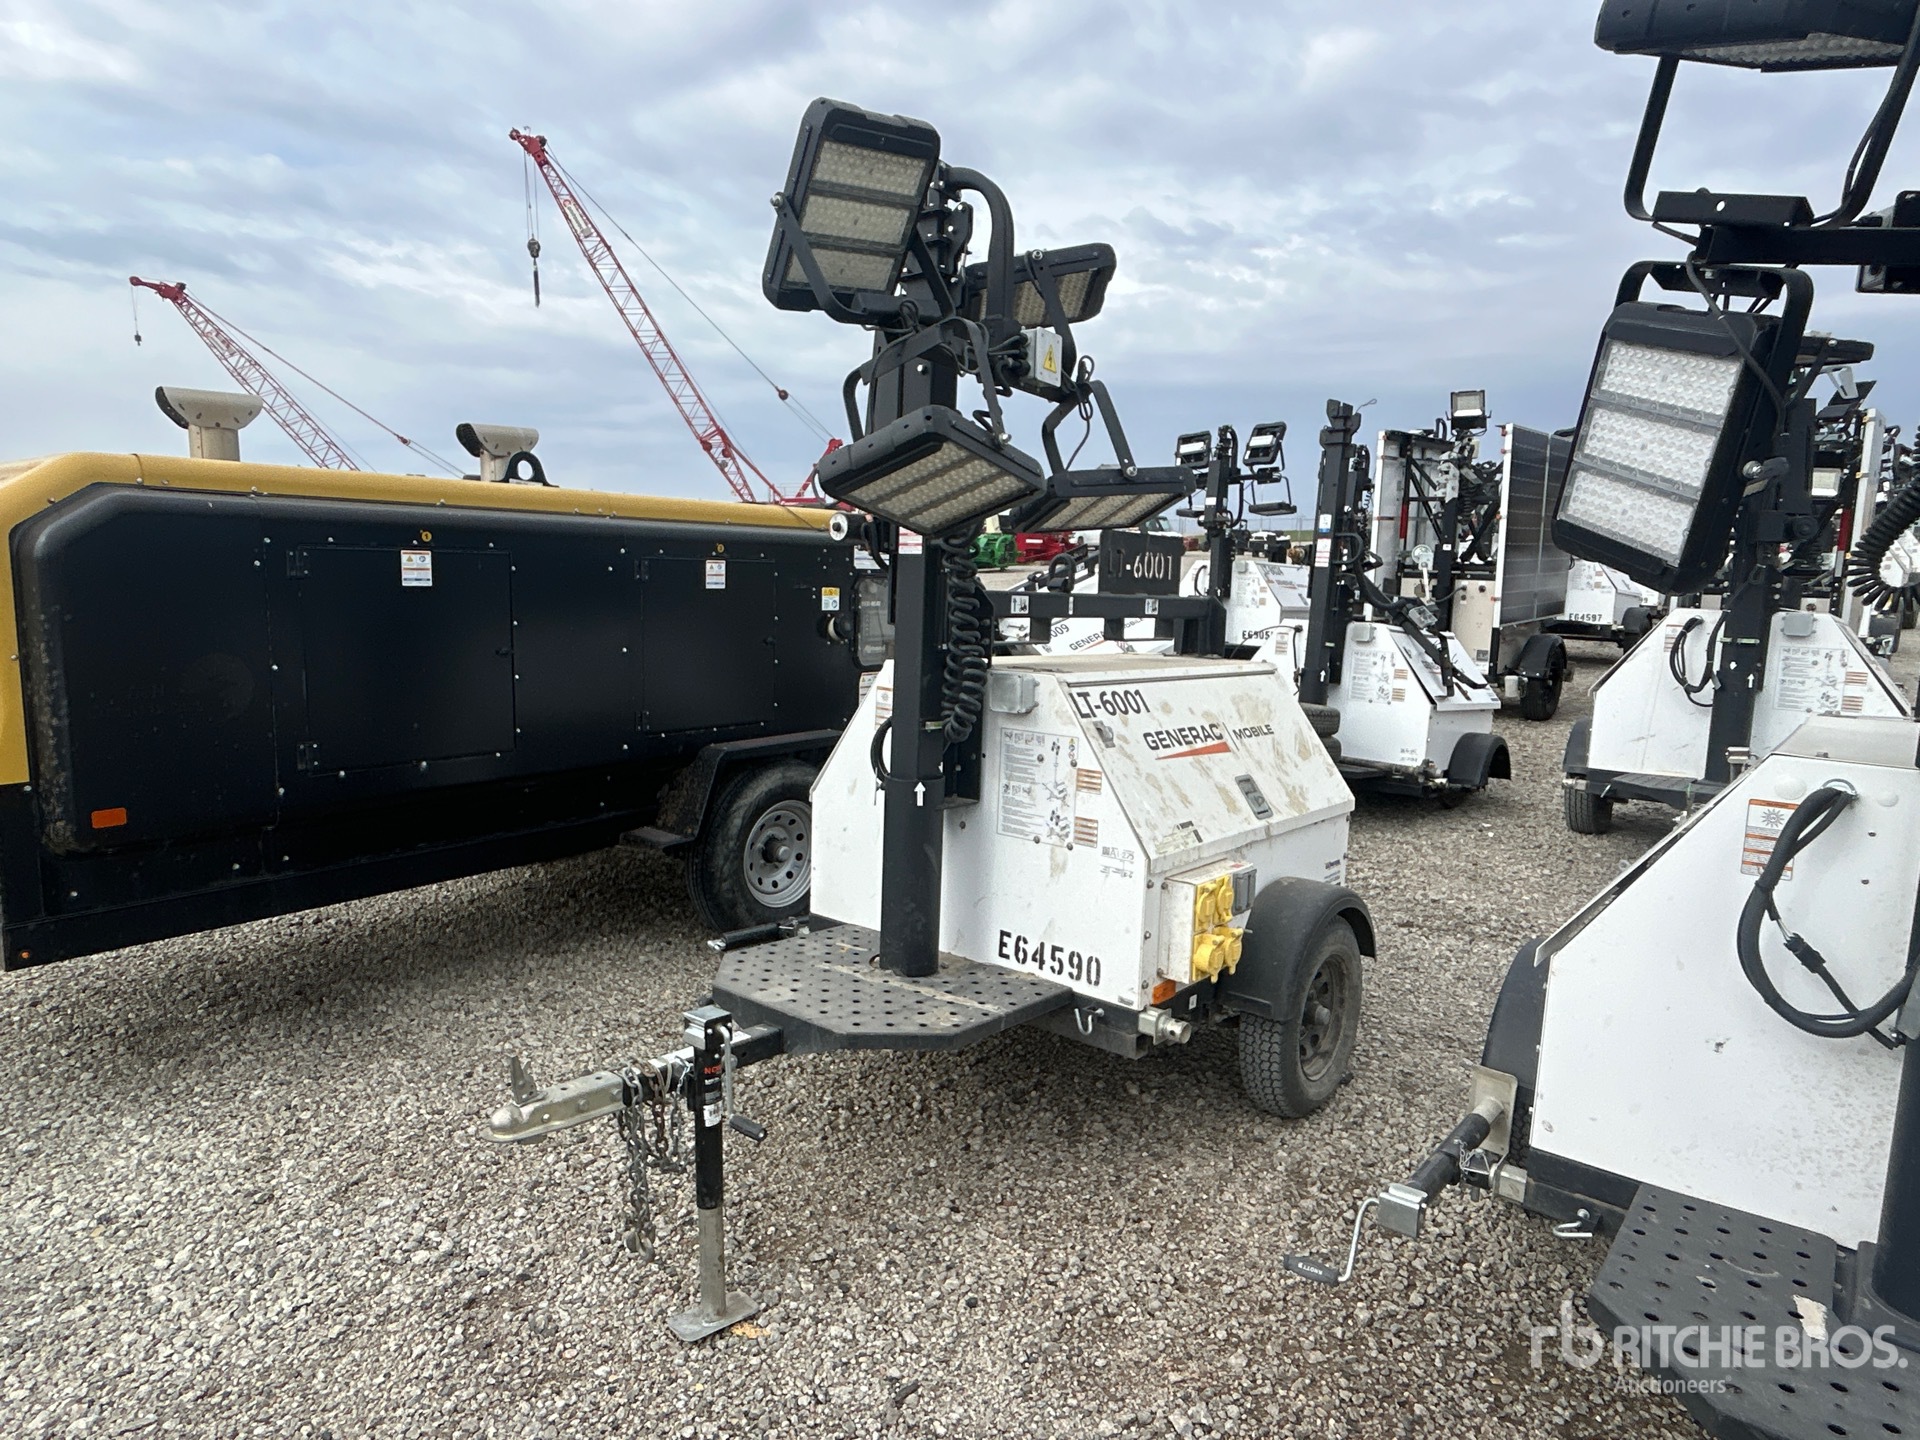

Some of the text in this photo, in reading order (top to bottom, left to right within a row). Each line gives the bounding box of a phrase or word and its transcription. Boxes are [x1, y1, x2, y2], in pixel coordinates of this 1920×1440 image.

[1568, 613, 1603, 622] E64597
[1050, 623, 1070, 639] 009
[1069, 630, 1105, 651] GENERA
[1069, 689, 1150, 719] LT-6001
[1143, 723, 1274, 751] GENERAC MOBILE
[998, 929, 1101, 987] E64590
